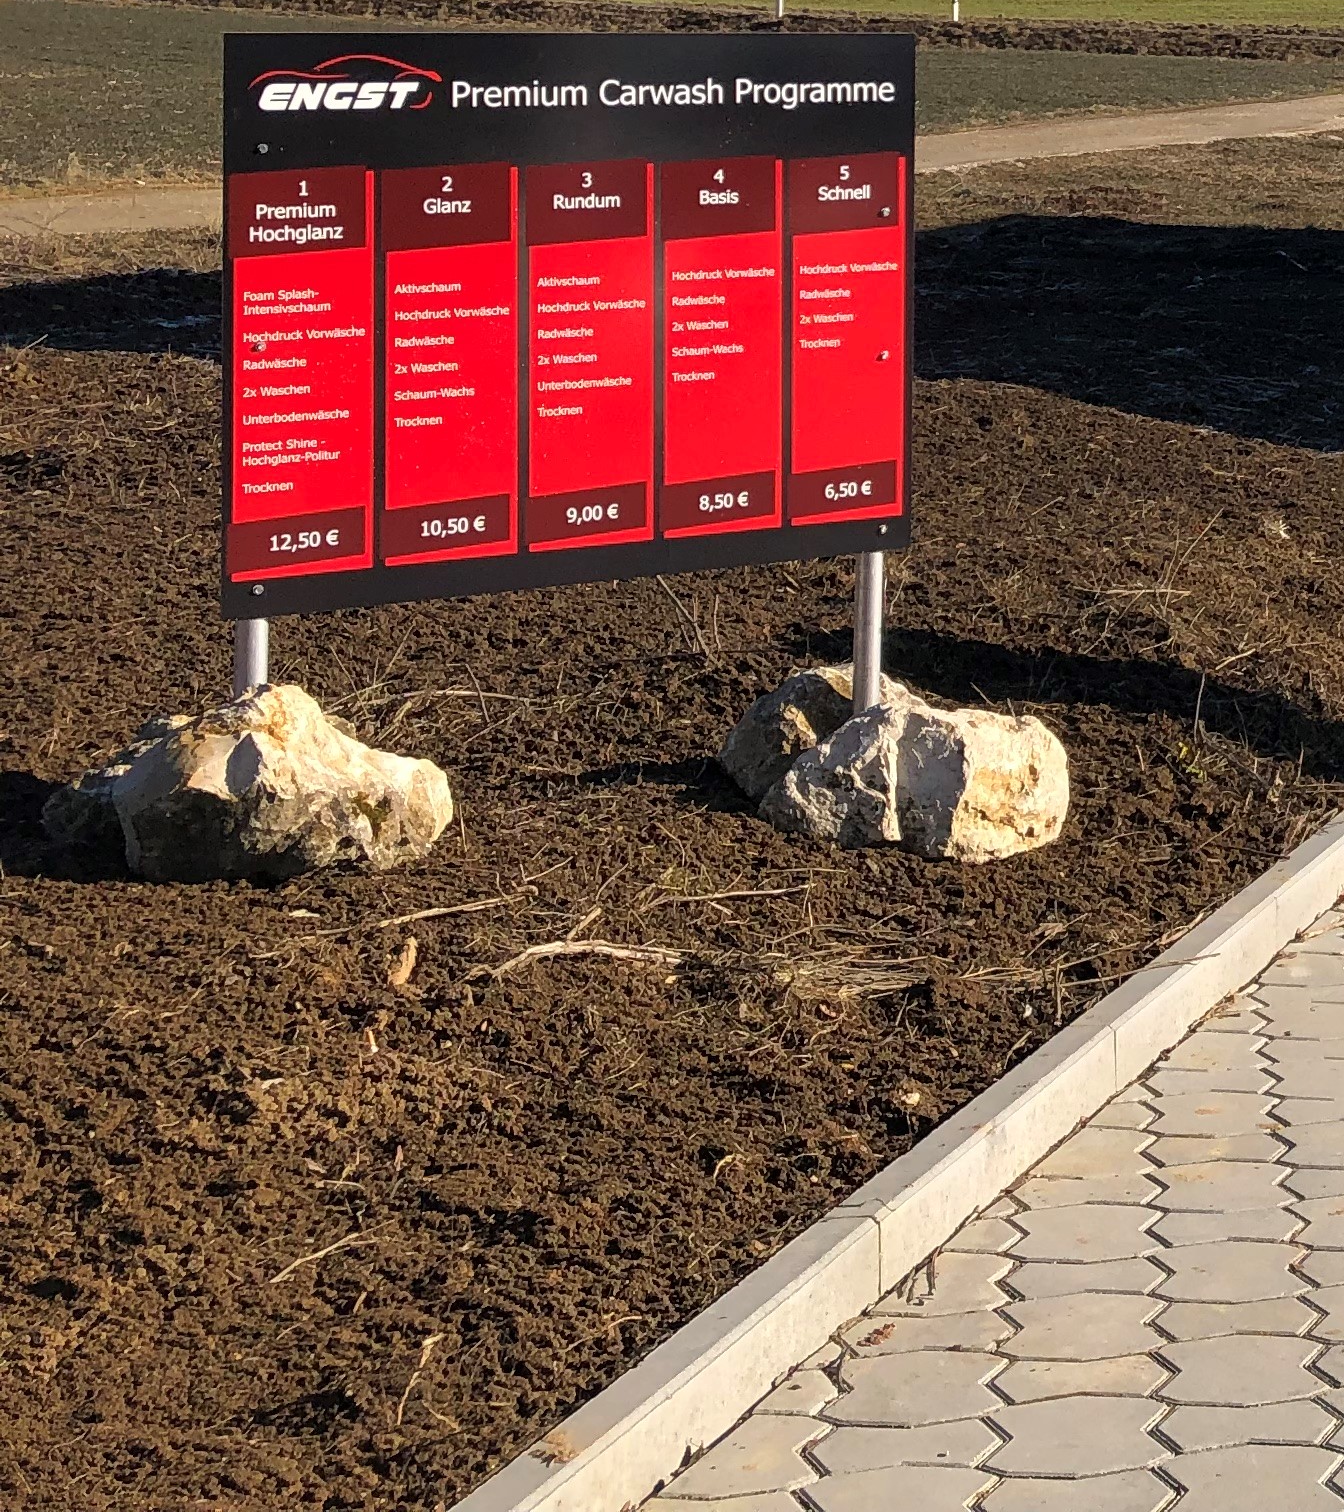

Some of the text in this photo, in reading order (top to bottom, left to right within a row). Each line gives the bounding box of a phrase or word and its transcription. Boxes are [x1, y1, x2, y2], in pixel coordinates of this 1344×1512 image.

[259, 82, 418, 110] ENGST
[453, 78, 895, 109] Premium Carwash Programme
[582, 172, 592, 188] 3
[714, 169, 724, 183] 4
[840, 166, 849, 180] 5
[299, 181, 308, 196] 1
[442, 176, 452, 191] 2
[700, 189, 739, 204] Basis
[818, 185, 870, 201] Schnell
[424, 198, 471, 214] Glanz
[554, 193, 620, 209] Rundum
[256, 203, 336, 220] Premium
[250, 224, 343, 244] Hochglanz
[672, 267, 775, 280] Hochdruck Vorwäsche
[800, 261, 898, 274] Hochdruck Vorwäsche
[394, 283, 461, 294] Aktivschaum
[537, 276, 600, 287] Aktivschaum
[244, 288, 319, 301] Foam Splash-
[672, 295, 725, 306] Radwäsche
[800, 288, 850, 299] Radwäsche
[243, 301, 331, 315] Intensivschaum
[538, 299, 646, 313] Hochdruck Vorwäsche
[395, 306, 509, 321] Hochdruck Vorwäsche
[800, 312, 853, 324] 2x Waschen
[672, 320, 728, 331] 2x Waschen
[243, 325, 365, 343] Hochdruck Vorwäsche
[538, 327, 593, 339] Radwäsche
[395, 335, 454, 347] Radwäsche
[799, 339, 840, 348] Trocknen
[672, 344, 744, 357] Schaum-Wachs
[243, 357, 306, 370] Radwäsche
[538, 353, 597, 365] 2x Waschen
[395, 362, 458, 374] 2x Waschen
[672, 371, 715, 382] Trocknen
[243, 385, 310, 397] 2x Waschen
[537, 376, 632, 392] Unterbodenwäsche
[394, 387, 475, 401] Schaum-Wachs
[243, 409, 349, 425] Unterbodenwäsche
[537, 405, 582, 417] Trocknen
[394, 416, 442, 427] Trocknen
[243, 440, 283, 452] Protect
[286, 439, 319, 451] Shine
[243, 449, 340, 466] Hochglanz-Politur
[242, 482, 293, 494] Trocknen
[825, 481, 871, 500] 6,50 €
[699, 492, 748, 512] 8,50 €
[567, 504, 618, 525] 9,00 €
[421, 516, 485, 538] 10,50 €
[270, 530, 339, 552] 12,50 €
